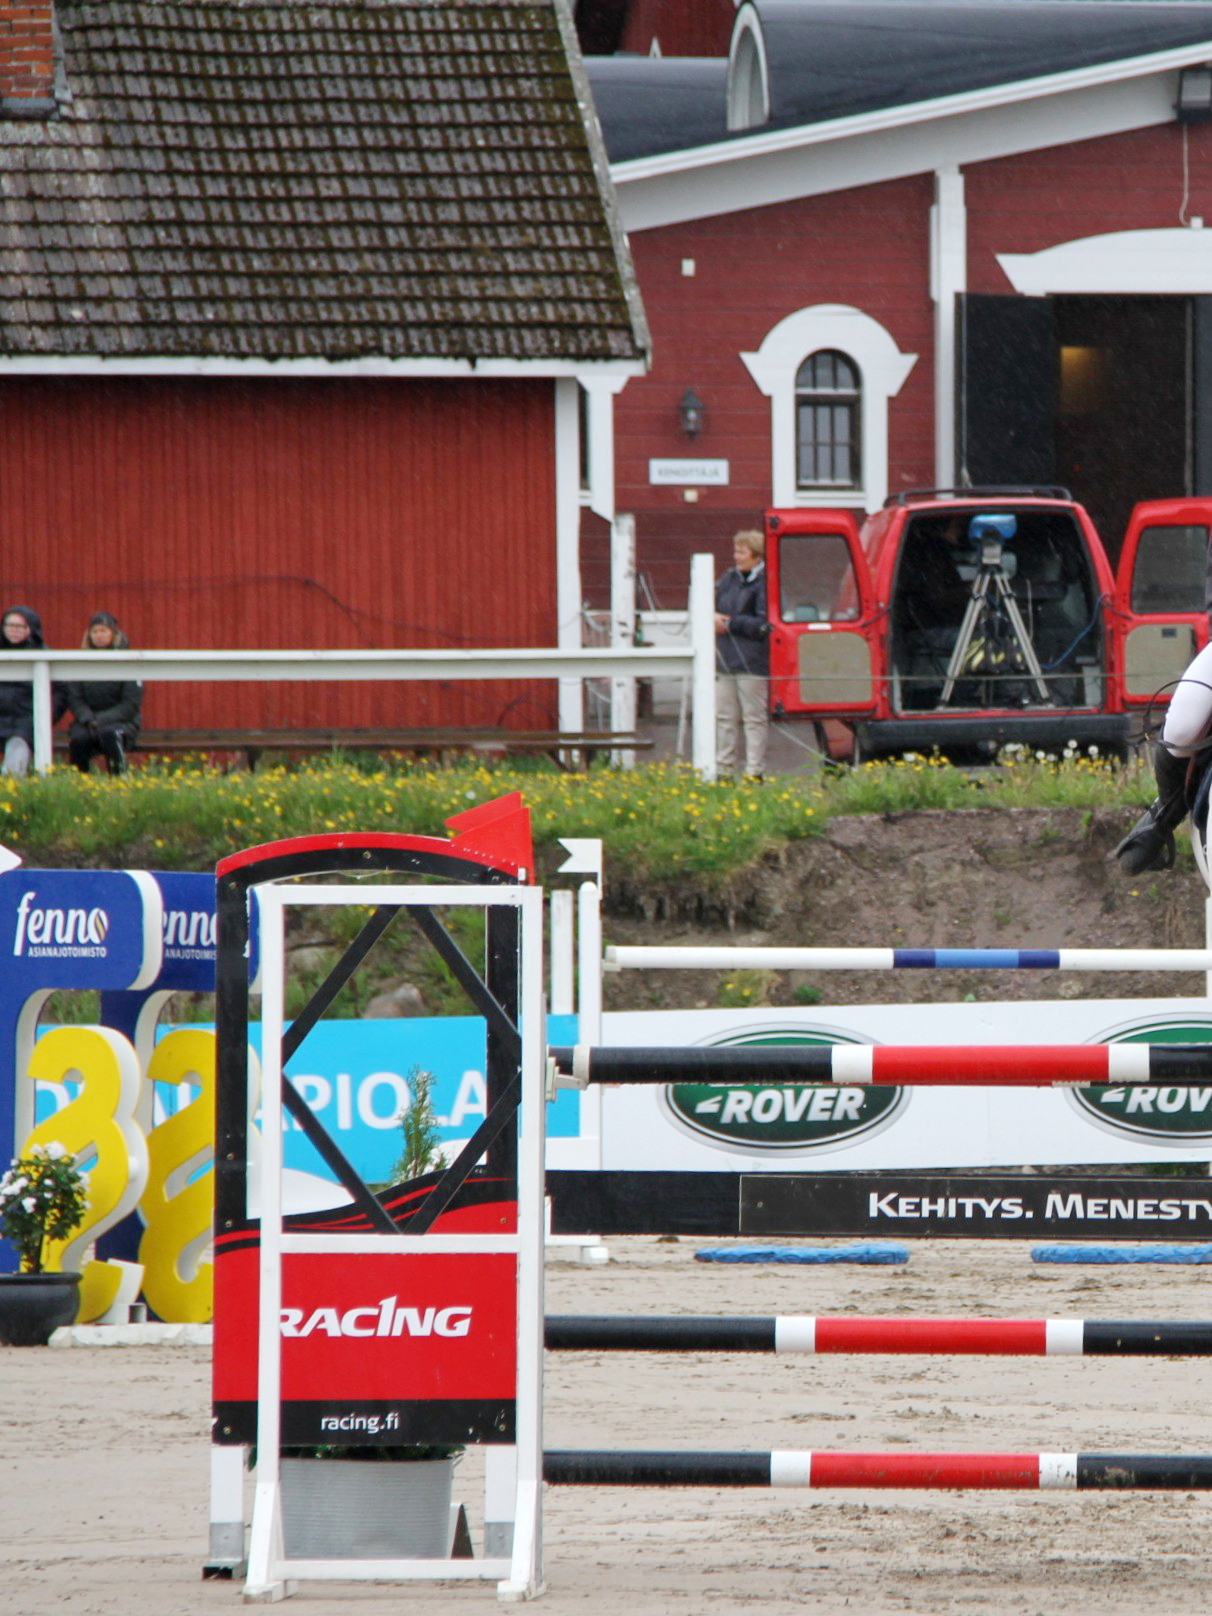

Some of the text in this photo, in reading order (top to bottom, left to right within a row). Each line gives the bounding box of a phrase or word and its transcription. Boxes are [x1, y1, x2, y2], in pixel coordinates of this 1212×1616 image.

[13, 891, 109, 956] fenno
[28, 946, 107, 958] ASIANAJOTOIMISTO
[719, 1087, 866, 1124] ROVER
[868, 1192, 1034, 1219] KEHITYS.
[279, 1295, 473, 1338] RACING
[320, 1411, 400, 1434] racing.fi
